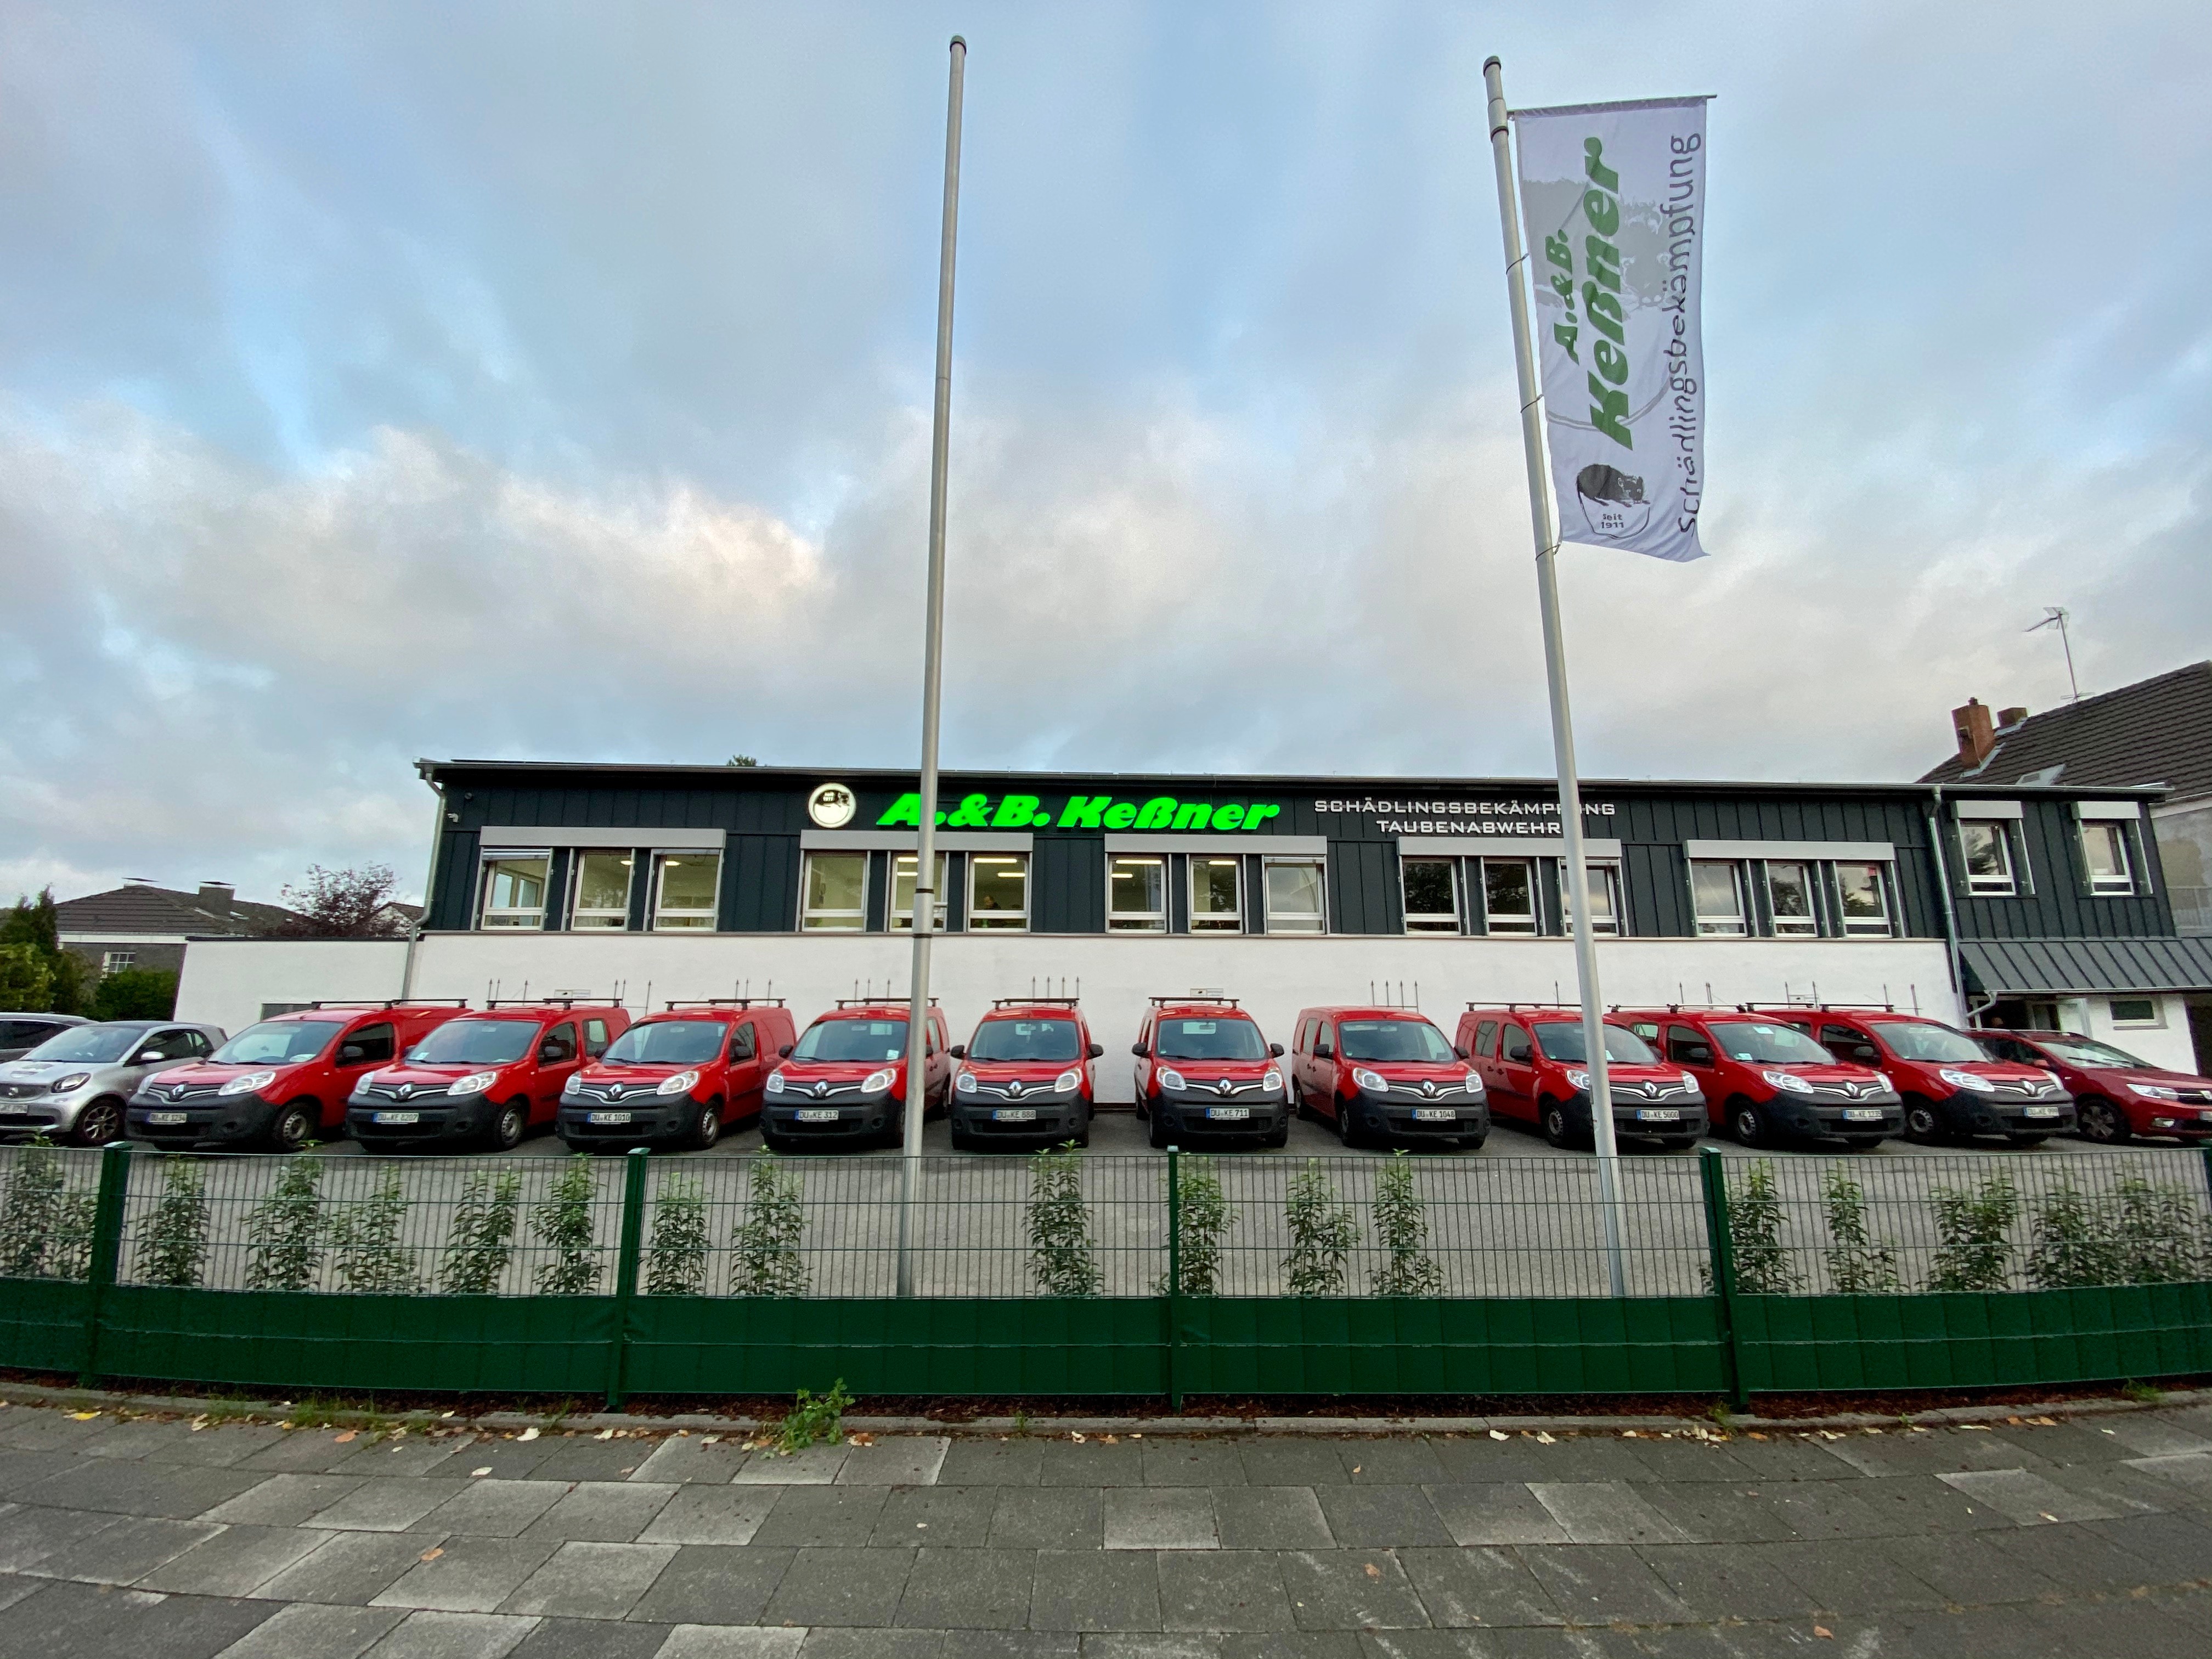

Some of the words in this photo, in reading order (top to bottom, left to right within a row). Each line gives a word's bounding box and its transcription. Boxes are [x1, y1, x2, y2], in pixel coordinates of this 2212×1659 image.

[1582, 137, 1633, 451] Keßner
[1660, 133, 1701, 537] Schädlingsbekämpfung
[1057, 795, 1280, 830] Keßner
[1314, 797, 1616, 815] SCHÄDLINGSBEKÄMPNG
[1376, 820, 1562, 834] TAUBENABWEHR
